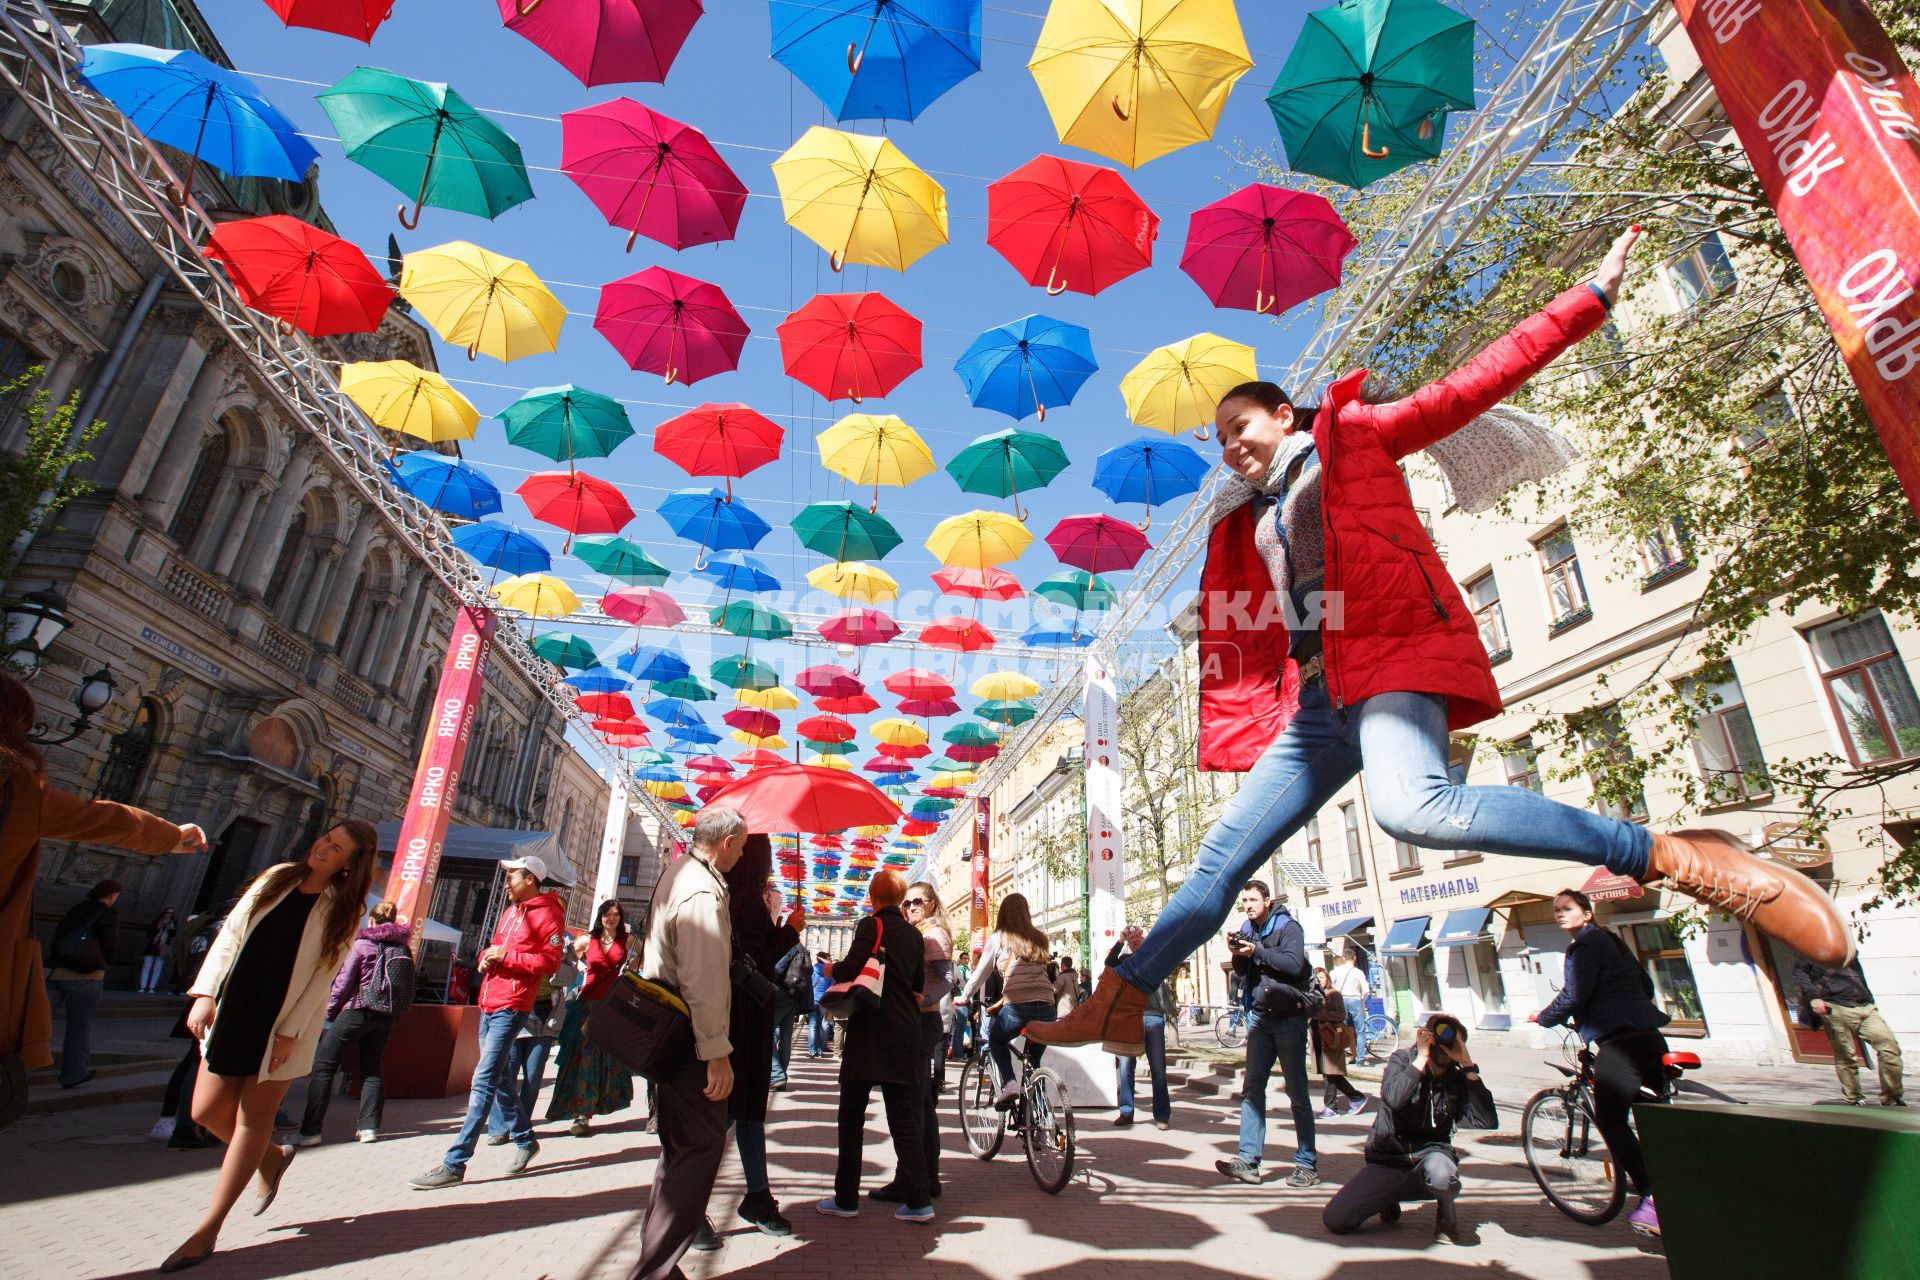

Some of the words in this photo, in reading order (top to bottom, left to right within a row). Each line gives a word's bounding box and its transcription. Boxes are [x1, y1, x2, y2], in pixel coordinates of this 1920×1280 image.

[1702, 0, 1762, 45] ЯР
[1758, 79, 1845, 197] ЯРКО
[454, 634, 478, 671] ЯРКО
[476, 639, 490, 677] ЯРКО
[438, 698, 462, 737] ЯРКО
[460, 704, 475, 743] ЯРКО
[420, 766, 445, 808] ЯРКО
[443, 770, 459, 812] ЯРКО
[976, 813, 986, 834] ЯРКО
[401, 838, 428, 882] ЯРКО
[426, 841, 442, 884] ЯРКО
[975, 849, 985, 872] ЯРКО
[974, 887, 984, 910] ЯРКО
[1400, 876, 1479, 904] МАТЕРИАЛЫ
[1589, 888, 1629, 901] КАРТИНЫ
[974, 926, 984, 949] ЯРКО
